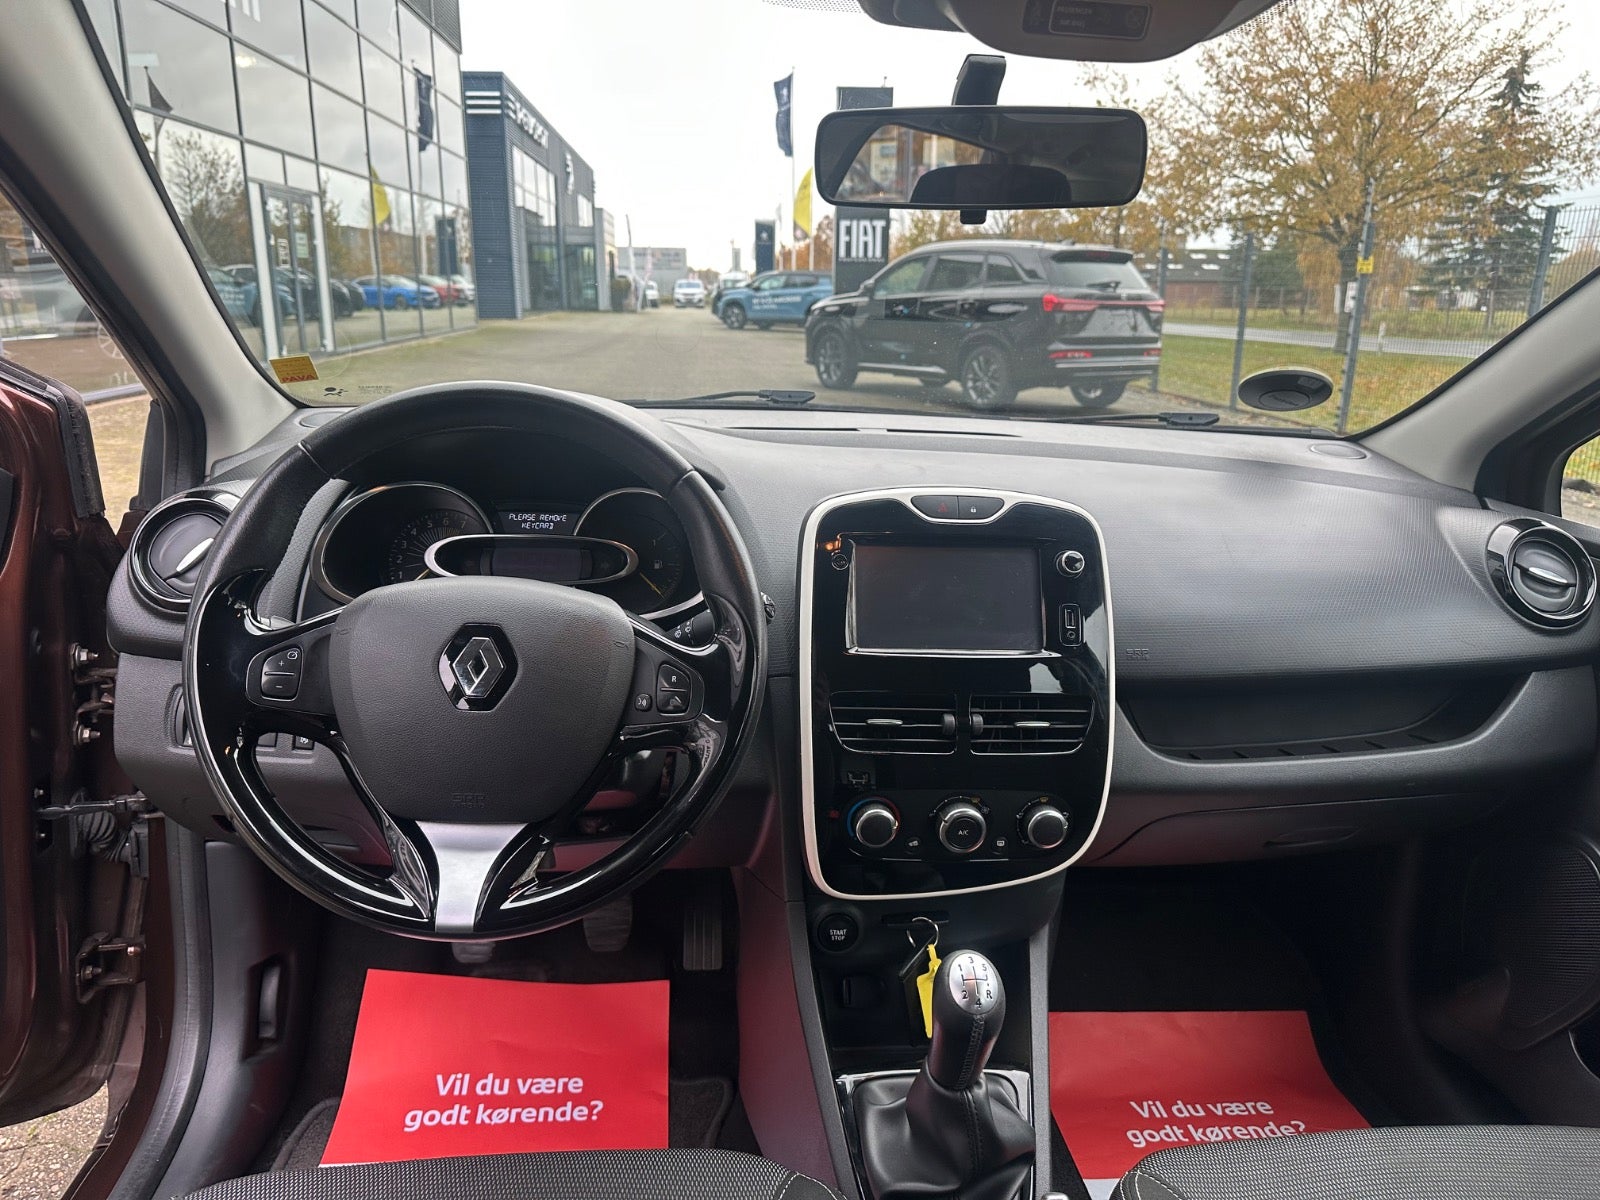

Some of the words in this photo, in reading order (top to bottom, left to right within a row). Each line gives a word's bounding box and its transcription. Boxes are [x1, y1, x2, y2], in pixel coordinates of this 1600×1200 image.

[838, 219, 886, 258] FIAT
[280, 374, 316, 383] PAVA
[508, 513, 536, 521] PLEASE
[539, 514, 567, 522] REMOVE
[521, 521, 554, 530] KEYCARD
[671, 675, 677, 683] R
[968, 956, 974, 964] 3
[958, 963, 963, 972] 1
[981, 963, 988, 972] 5
[961, 989, 969, 1000] 2
[985, 989, 993, 1000] R
[975, 997, 982, 1008] 4
[436, 1073, 470, 1096] Vil
[475, 1073, 510, 1095] du
[517, 1077, 584, 1095] være
[1130, 1100, 1168, 1118] Vil
[1171, 1100, 1206, 1117] du
[1207, 1101, 1274, 1116] være
[403, 1104, 470, 1132] godt
[475, 1100, 604, 1126] kørende?
[1126, 1124, 1188, 1148] godt
[1187, 1120, 1306, 1142] kørende?
